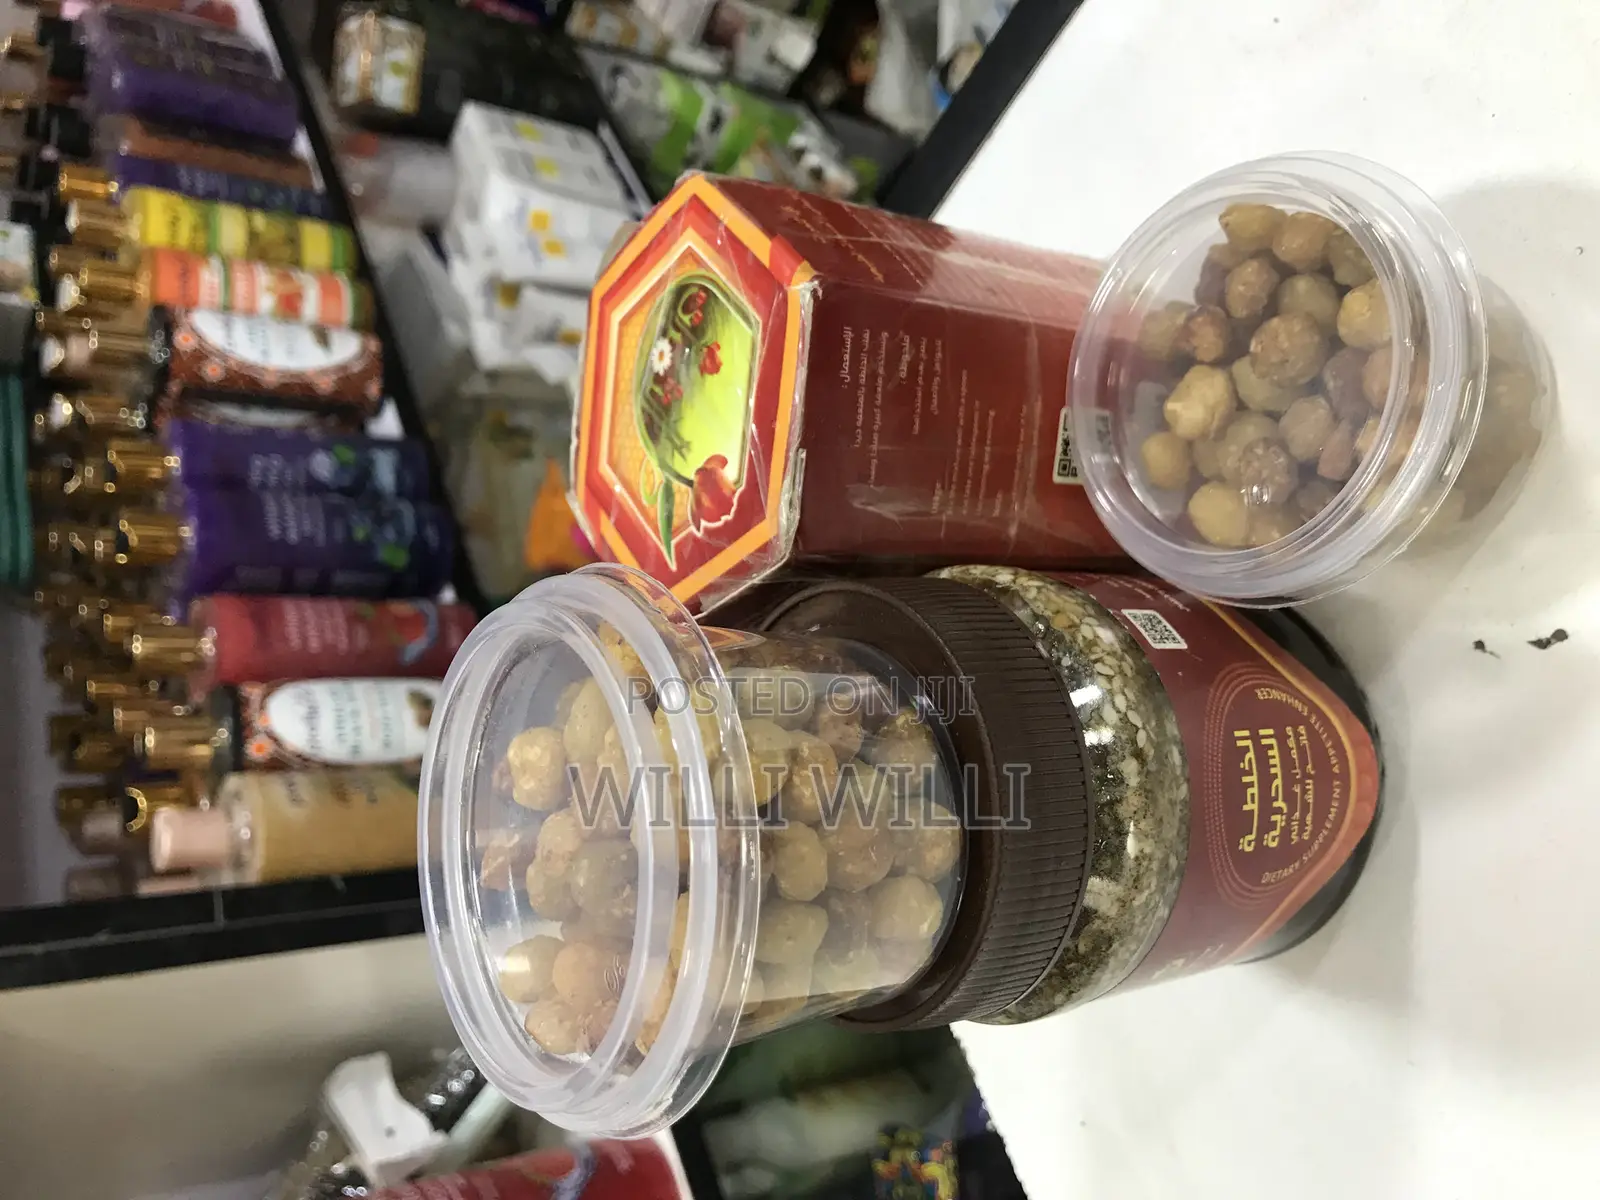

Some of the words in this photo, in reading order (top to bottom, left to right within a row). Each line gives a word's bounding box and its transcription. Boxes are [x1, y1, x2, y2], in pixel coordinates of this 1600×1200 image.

[1234, 729, 1259, 852] الخلطة
[1258, 728, 1287, 848] السحرية
[1307, 714, 1342, 774] APPETITE
[1300, 778, 1343, 861] SUPPLEMENT
